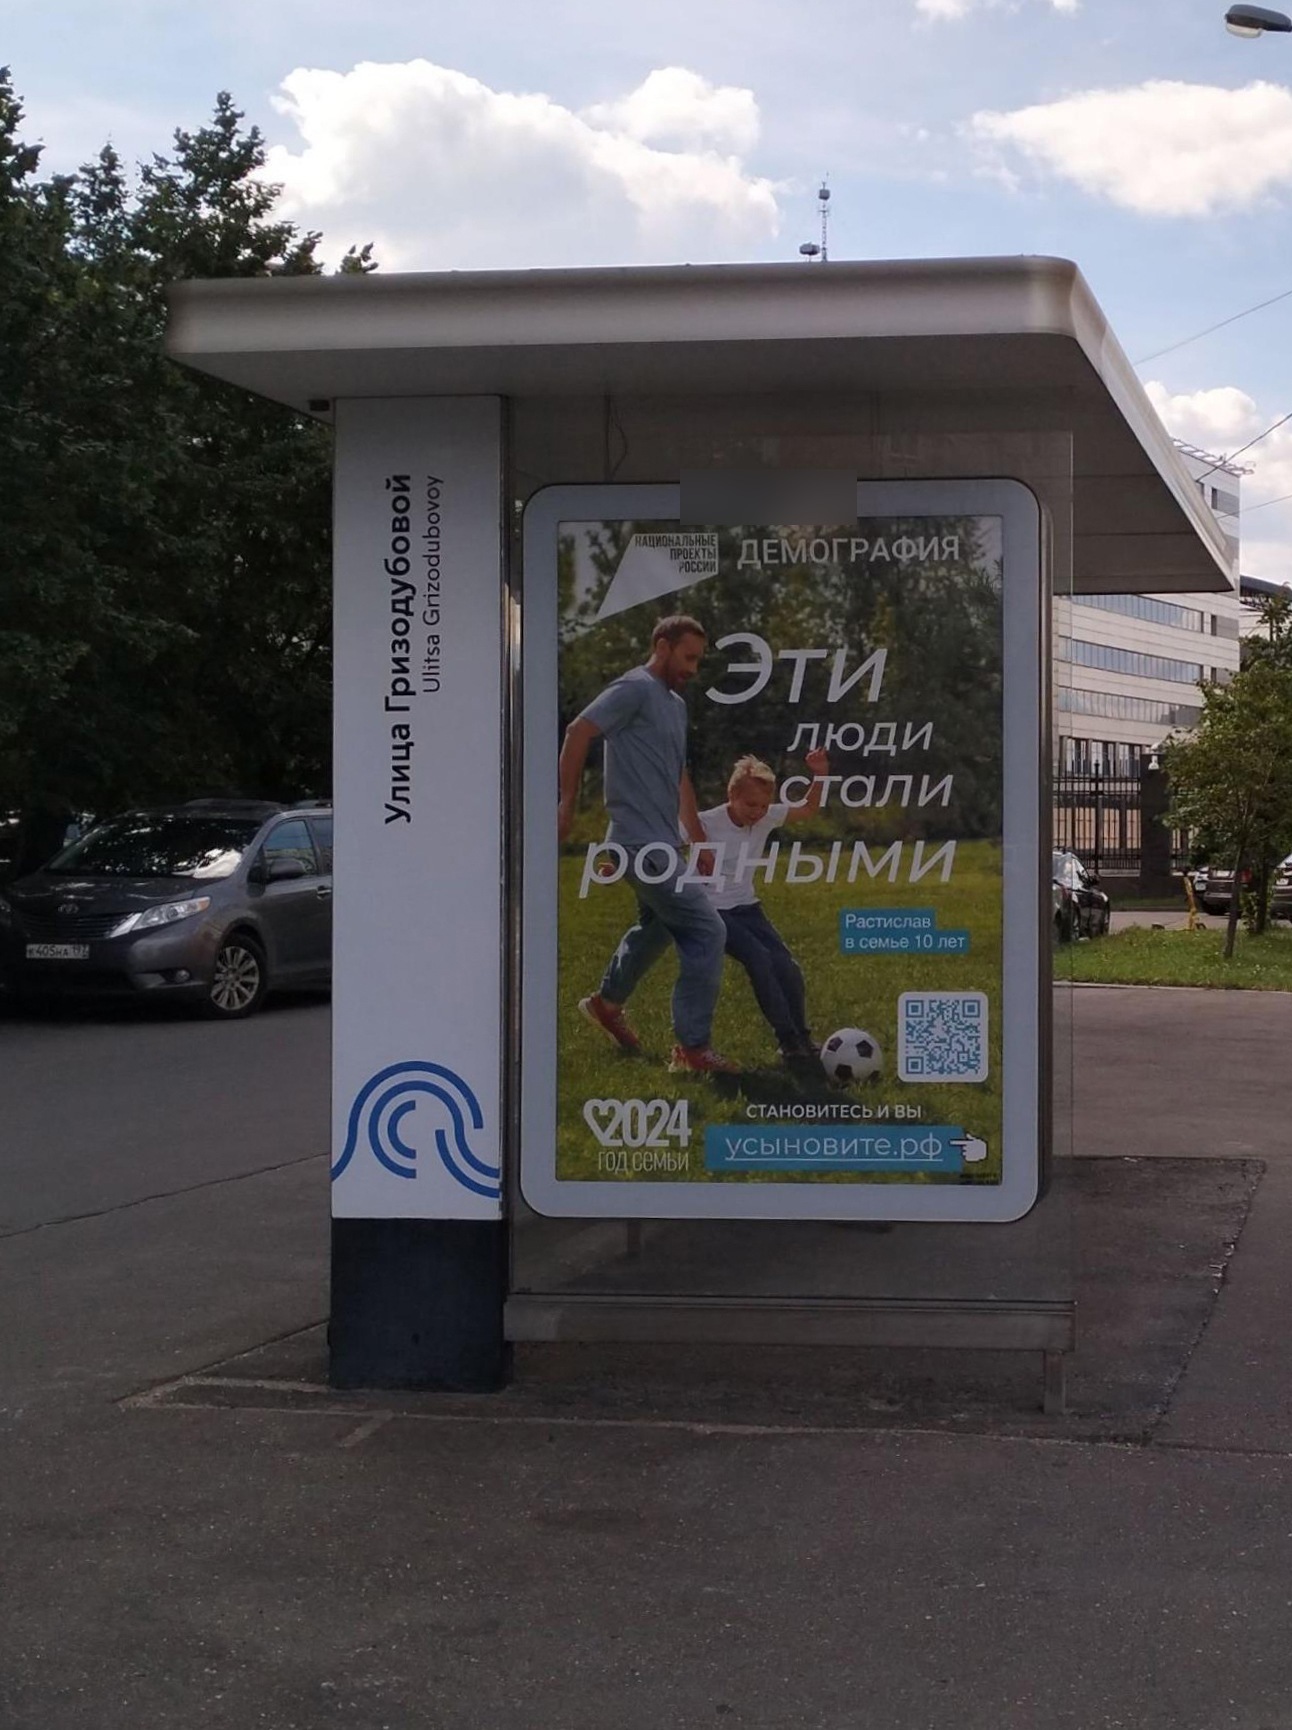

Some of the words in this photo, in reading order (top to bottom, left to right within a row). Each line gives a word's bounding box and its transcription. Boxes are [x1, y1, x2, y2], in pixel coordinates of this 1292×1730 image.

[421, 475, 444, 626] Grizodubovoy
[634, 534, 717, 549] НАЦИОНАЛЬНЫЕ
[669, 548, 717, 561] ПРОЕКТЫ
[736, 534, 961, 570] ДЕМОГРАФИЯ
[679, 561, 717, 574] РОССИИ
[383, 474, 417, 712] Гризодубовой
[421, 634, 440, 693] Ulitsa
[705, 632, 888, 705] Эти
[787, 721, 934, 757] люди
[384, 723, 414, 825] Улица
[779, 774, 954, 809] стали
[579, 839, 958, 899] родными
[845, 913, 931, 929] Растислав
[845, 937, 855, 949] в
[859, 936, 909, 949] семье
[915, 934, 933, 949] 10
[937, 936, 965, 949] лет
[597, 1098, 692, 1148] 2024
[746, 1104, 873, 1119] СТАНОВИТЕСЬ
[877, 1104, 889, 1118] И
[894, 1104, 922, 1119] ВЫ
[725, 1132, 943, 1161] усыновите.рф
